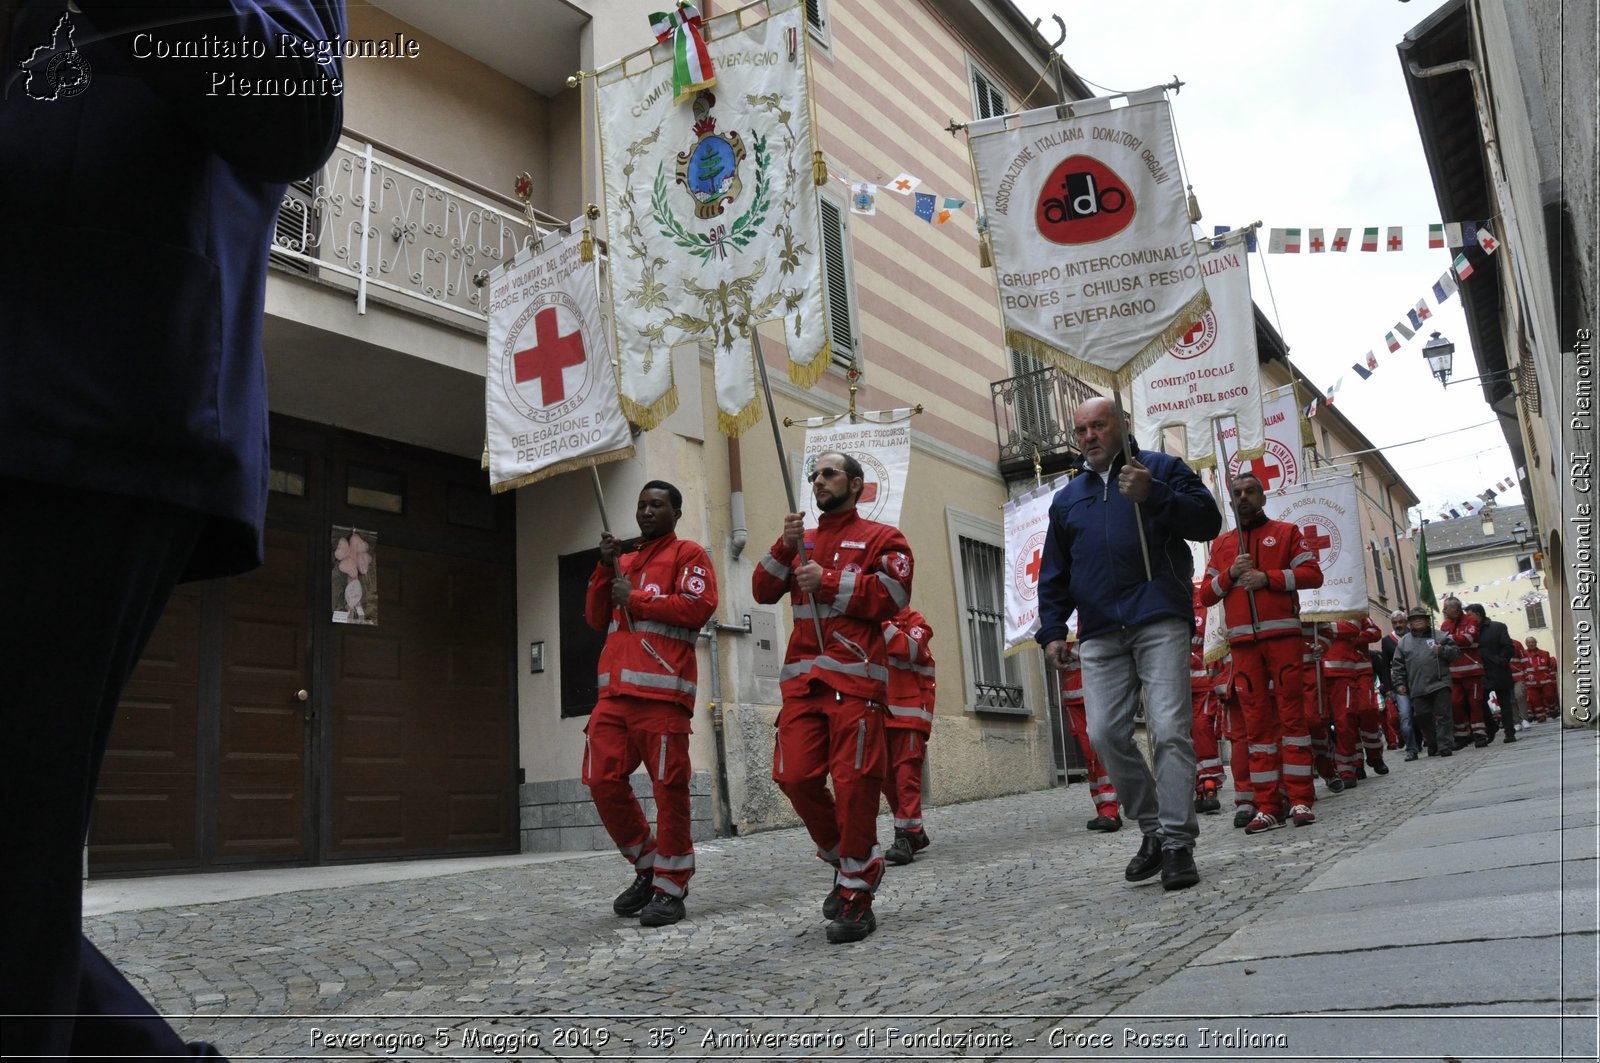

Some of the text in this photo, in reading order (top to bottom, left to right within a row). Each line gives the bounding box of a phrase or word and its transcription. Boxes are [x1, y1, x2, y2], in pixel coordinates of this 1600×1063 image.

[631, 51, 779, 118] COMUN EVERAGNO
[995, 127, 1170, 215] ASSOCIAZIONE ITALIANA DONATORI ORGANI
[1043, 173, 1126, 224] aido
[546, 260, 558, 272] DEL
[560, 243, 581, 266] SOCCORS
[1002, 242, 1191, 287] GRUPPO INTERCOMUNALE
[490, 258, 586, 314] CROCE ROSSA ITALIAN
[1006, 291, 1060, 309] BOVES
[1083, 276, 1143, 298] CHIUSA
[1150, 265, 1196, 287] PESIO
[504, 295, 546, 357] CONVENZIONE
[551, 294, 560, 303] DI
[1053, 299, 1156, 330] PEVERAGNO
[1150, 362, 1235, 389] COMITATO LOCALE
[1189, 383, 1198, 393] DI
[1146, 386, 1248, 416] SOMMARIVA DEL BOSCO
[512, 410, 605, 448] DELEGAZIONE DI
[836, 440, 865, 451] ROSSA
[868, 437, 909, 447] ITALIANA
[874, 428, 905, 438] SOCCORSO
[517, 429, 602, 464] PEVERAGNO
[1272, 444, 1295, 475] GINEVRA
[866, 456, 888, 481] GINEVRA
[1292, 498, 1316, 510] ROSSA
[1319, 498, 1346, 516] ITALIANA
[1301, 598, 1340, 608] RONERO
